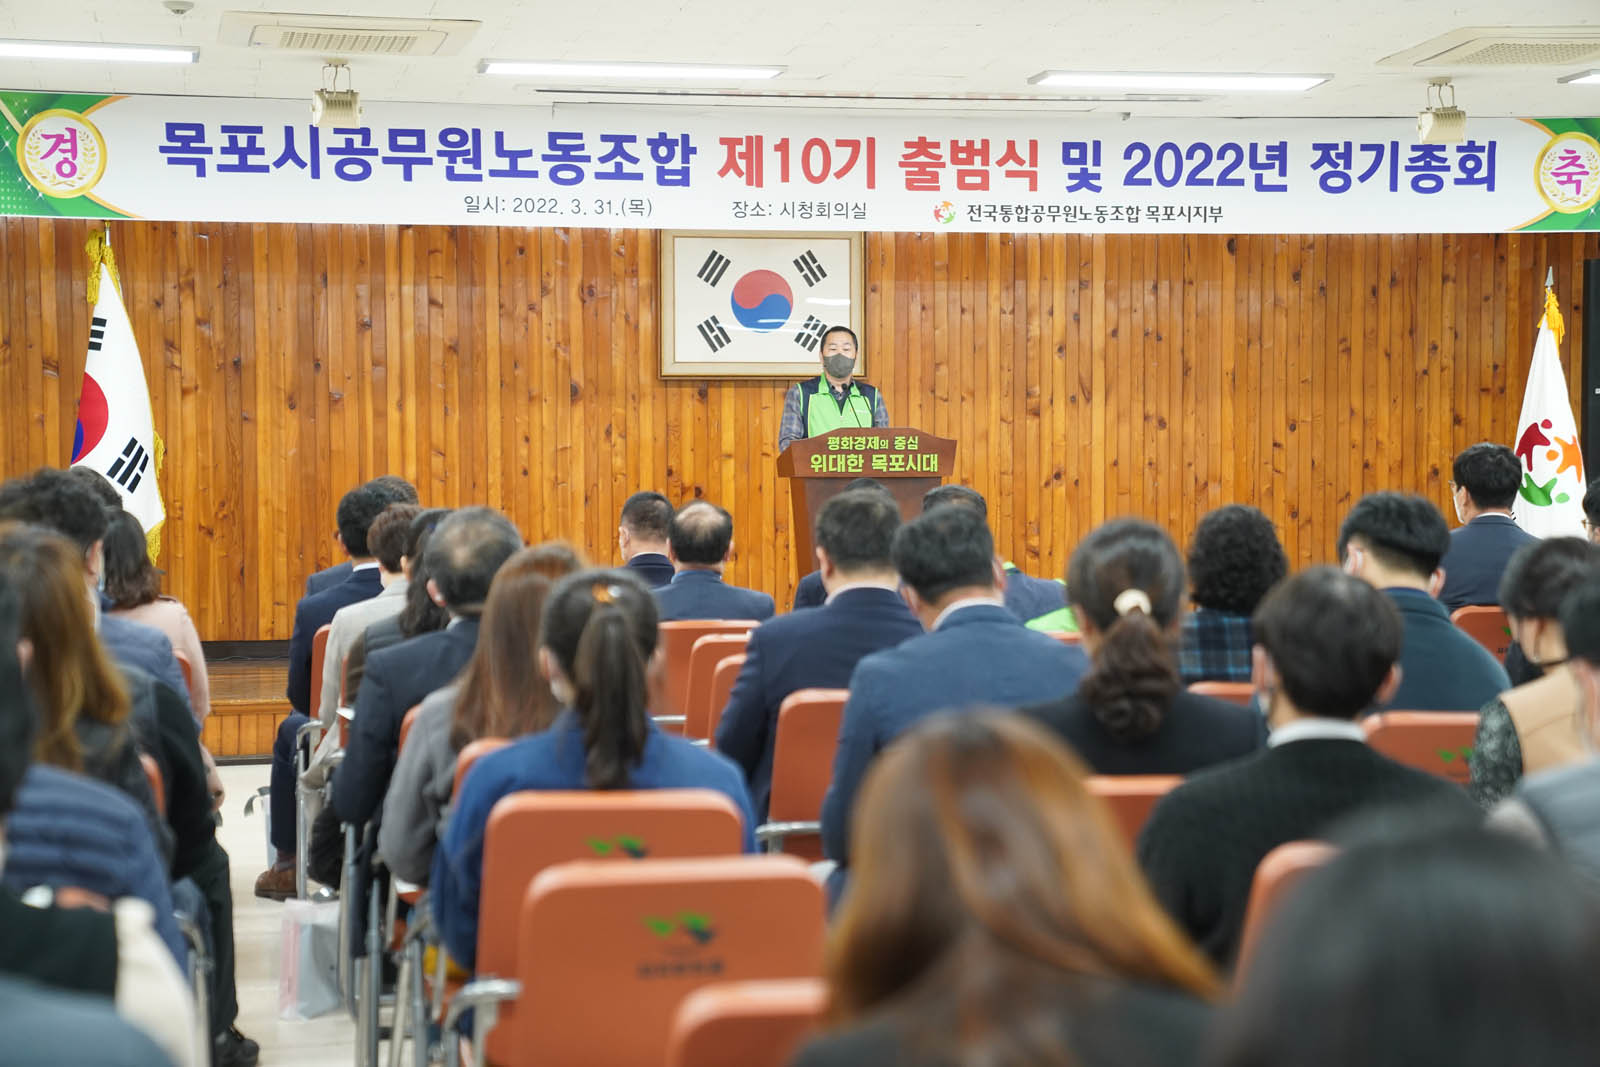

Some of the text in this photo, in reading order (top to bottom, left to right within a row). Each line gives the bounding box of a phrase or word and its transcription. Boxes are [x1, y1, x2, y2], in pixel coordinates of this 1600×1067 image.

[40, 127, 78, 179] 경
[159, 122, 1497, 195] 목포시공무원노동조합 제10기 출범식 및 2022년 정기총회
[1551, 148, 1590, 195] 축
[464, 195, 505, 214] 일시:
[512, 197, 564, 215] 2022.
[732, 200, 866, 220] 장소: 시청회의실
[967, 204, 1224, 224] 전국통합공무원노동조합 목포시지부
[827, 435, 919, 451] 평화경제의 중심
[810, 453, 939, 473] 위대한 목포시대
